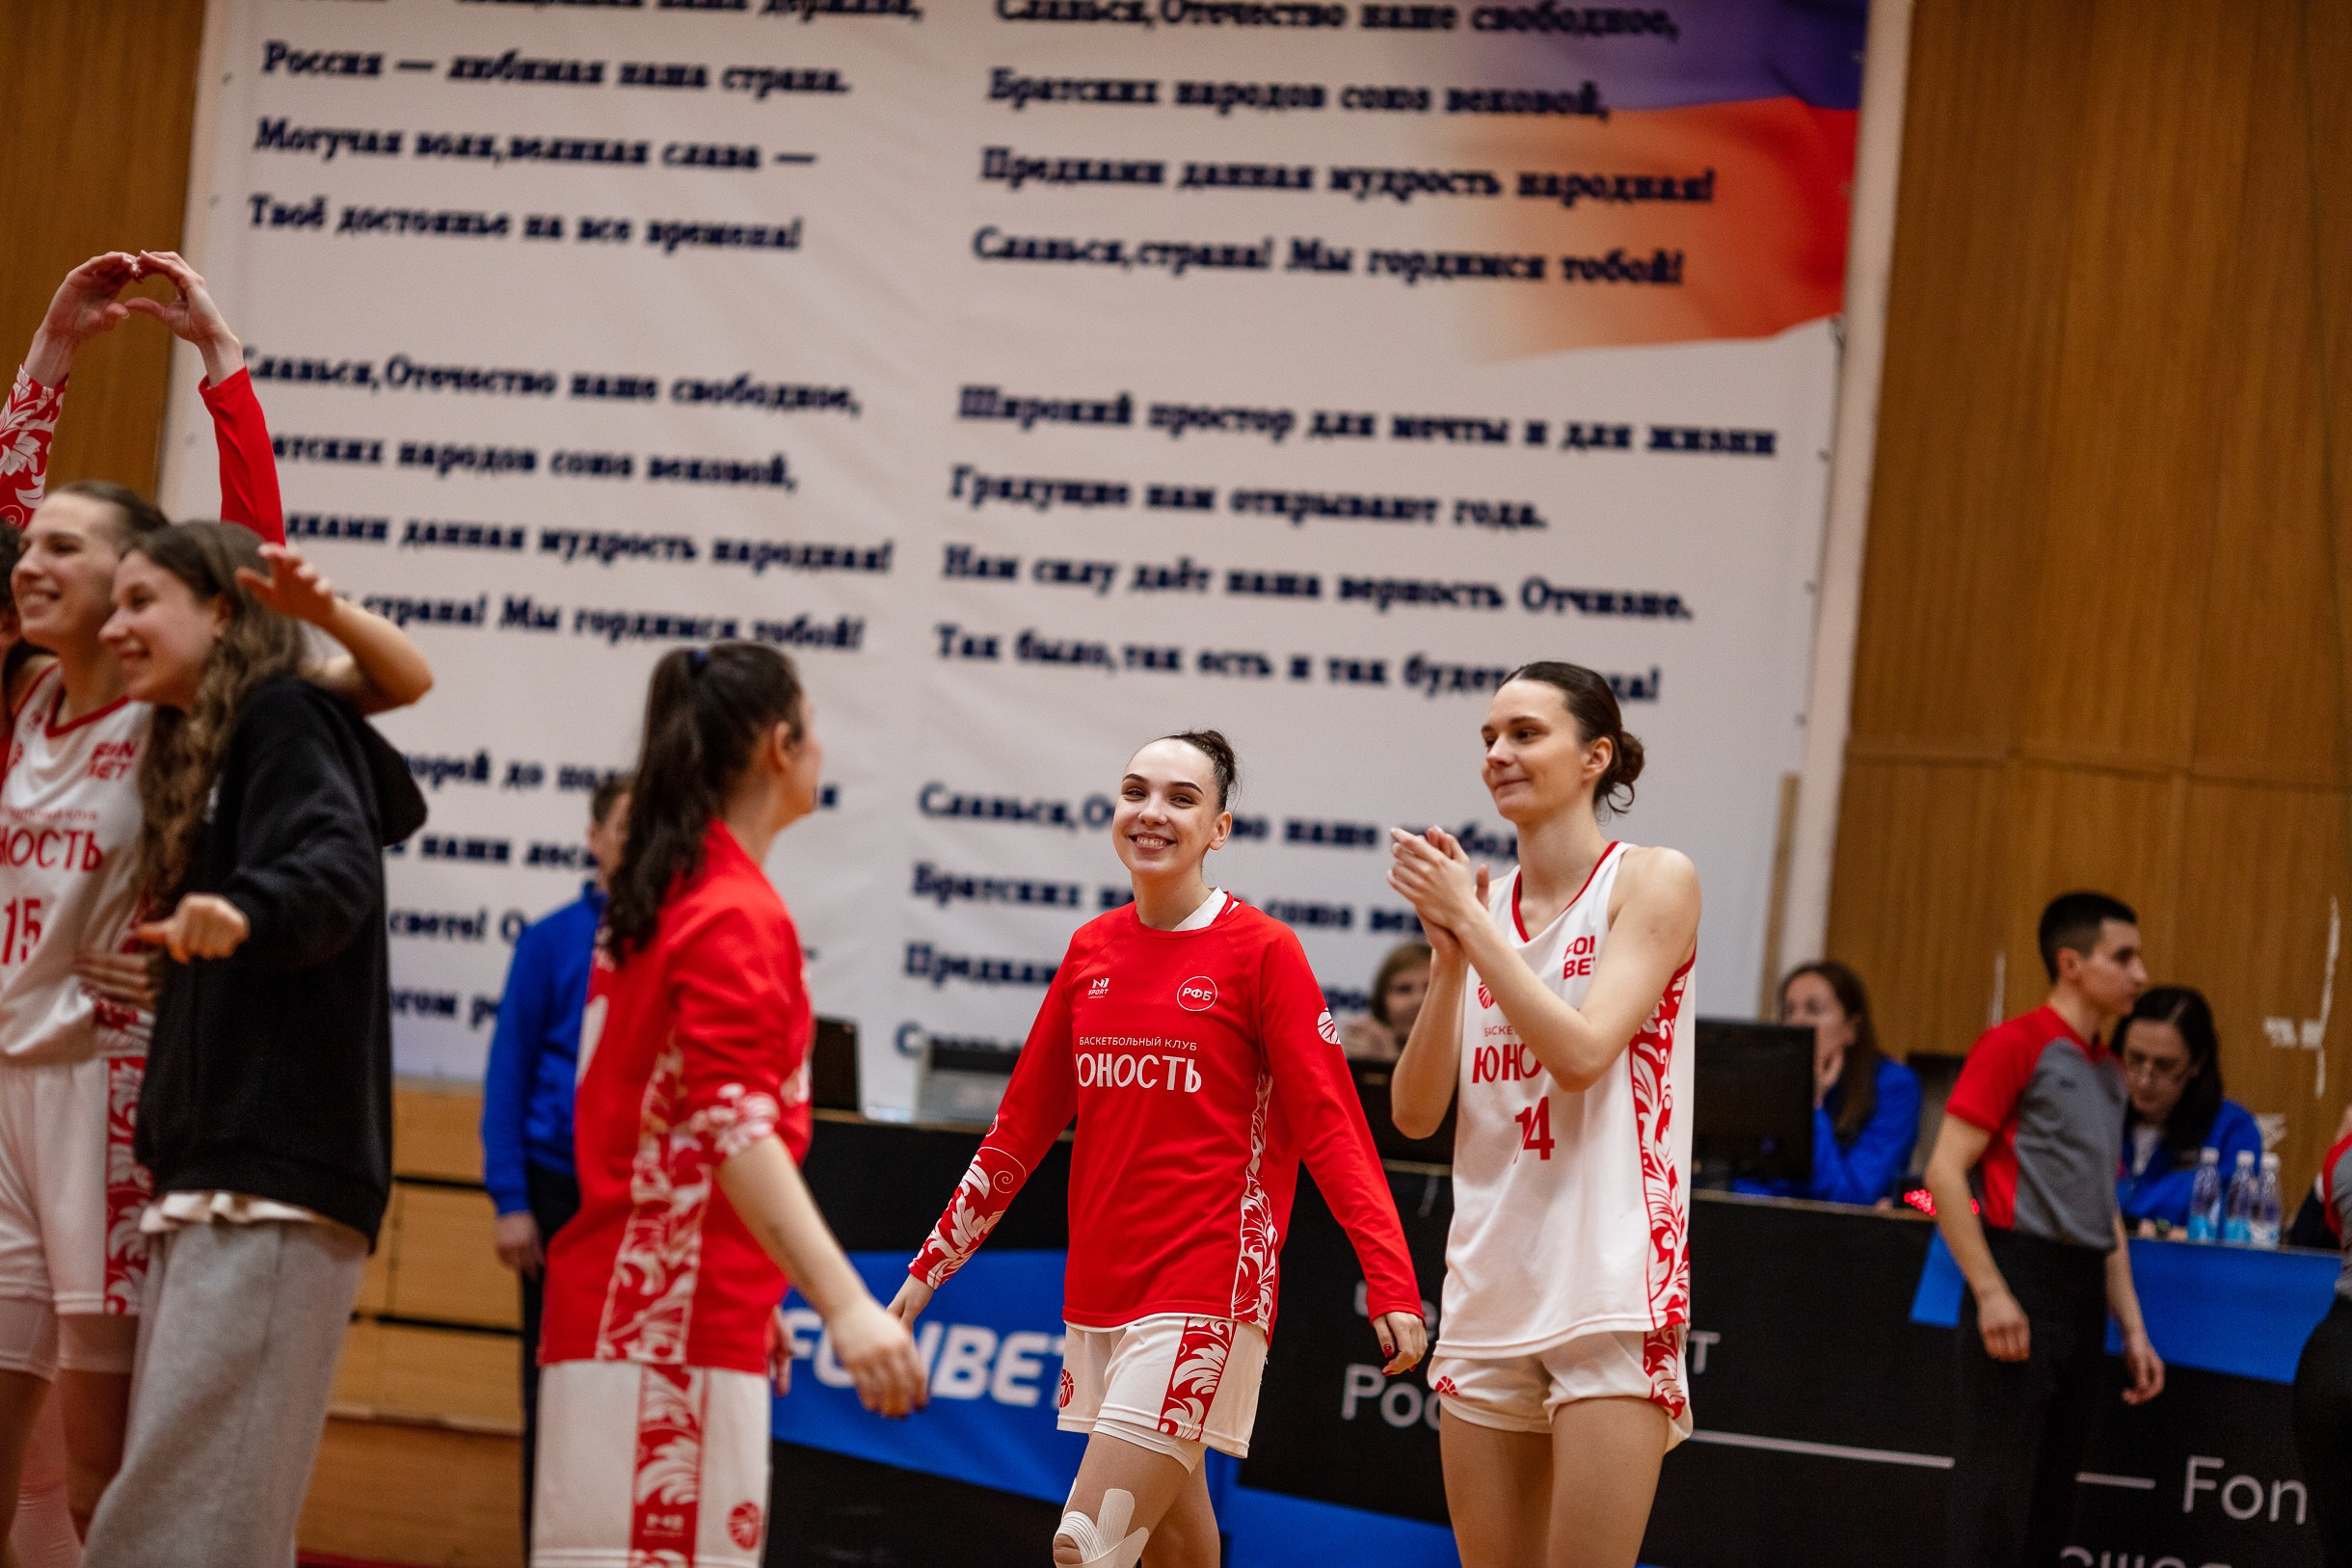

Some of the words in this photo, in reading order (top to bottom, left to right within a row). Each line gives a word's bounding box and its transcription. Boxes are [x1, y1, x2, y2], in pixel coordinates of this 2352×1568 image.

[262, 40, 384, 78] Россия
[447, 50, 605, 86] любимая
[618, 63, 709, 90] наша
[722, 67, 851, 100] страна.
[987, 67, 1160, 110] Братских
[1175, 82, 1327, 117] народов
[1340, 87, 1432, 113] союз
[254, 118, 403, 161] Могучая
[662, 145, 762, 171] слава
[981, 147, 1166, 190] Предками
[1178, 163, 1315, 192] данная
[1328, 168, 1503, 203] мудрость
[1517, 168, 1717, 209] народная!
[249, 195, 327, 229] Твоё
[337, 207, 511, 238] достоянье
[524, 216, 565, 241] на
[577, 219, 632, 243] все
[646, 221, 802, 254] времена!
[1286, 239, 1353, 274] Мы
[1368, 251, 1547, 286] гордимся
[1561, 249, 1684, 287] тобой!
[571, 375, 658, 401] наше
[671, 374, 860, 415] свободное,
[958, 385, 1134, 431] Широкий
[1149, 405, 1296, 443] простор
[1309, 412, 1376, 439] для
[1391, 416, 1510, 444] мечты
[1524, 420, 1549, 447] и
[1563, 423, 1633, 451] для
[1647, 426, 1777, 457] жизни
[272, 436, 384, 465] атских
[398, 443, 539, 477] народов
[550, 452, 634, 479] союз
[647, 455, 796, 492] вековой,
[951, 465, 1131, 511] Грядущие
[1146, 486, 1216, 512] нам
[1230, 491, 1439, 525] открывают
[1454, 500, 1547, 530] года.
[284, 514, 389, 543] дками
[401, 521, 526, 551] данная
[540, 530, 698, 566] мудрость
[712, 540, 894, 574] народная!
[944, 545, 1020, 581] Нам
[1033, 561, 1116, 595] силу
[1226, 571, 1323, 599] наша
[1338, 577, 1506, 613] верность
[1521, 577, 1693, 620] Отчизне.
[500, 597, 561, 632] Мы
[574, 608, 737, 645] гордимся
[753, 612, 865, 651] тобой!
[937, 625, 1001, 661] Так
[1197, 651, 1273, 678] есть
[1288, 655, 1312, 681] и
[1327, 658, 1388, 686] так
[403, 749, 490, 789] орей
[501, 761, 545, 792] до
[421, 836, 512, 864] наши
[1285, 820, 1380, 849] наше
[913, 863, 1080, 908] Братских
[3, 897, 41, 966] 15
[1182, 987, 1213, 1002] РФБ
[1563, 957, 1595, 980] BE
[1079, 1036, 1162, 1048] БАСКЕТБОЛЬНЫЙ
[1164, 1038, 1197, 1051] КЛУБ
[1471, 1043, 1542, 1084] ЮНО
[1075, 1052, 1202, 1093] ЮНОСТЬ
[1512, 1096, 1556, 1162] 14
